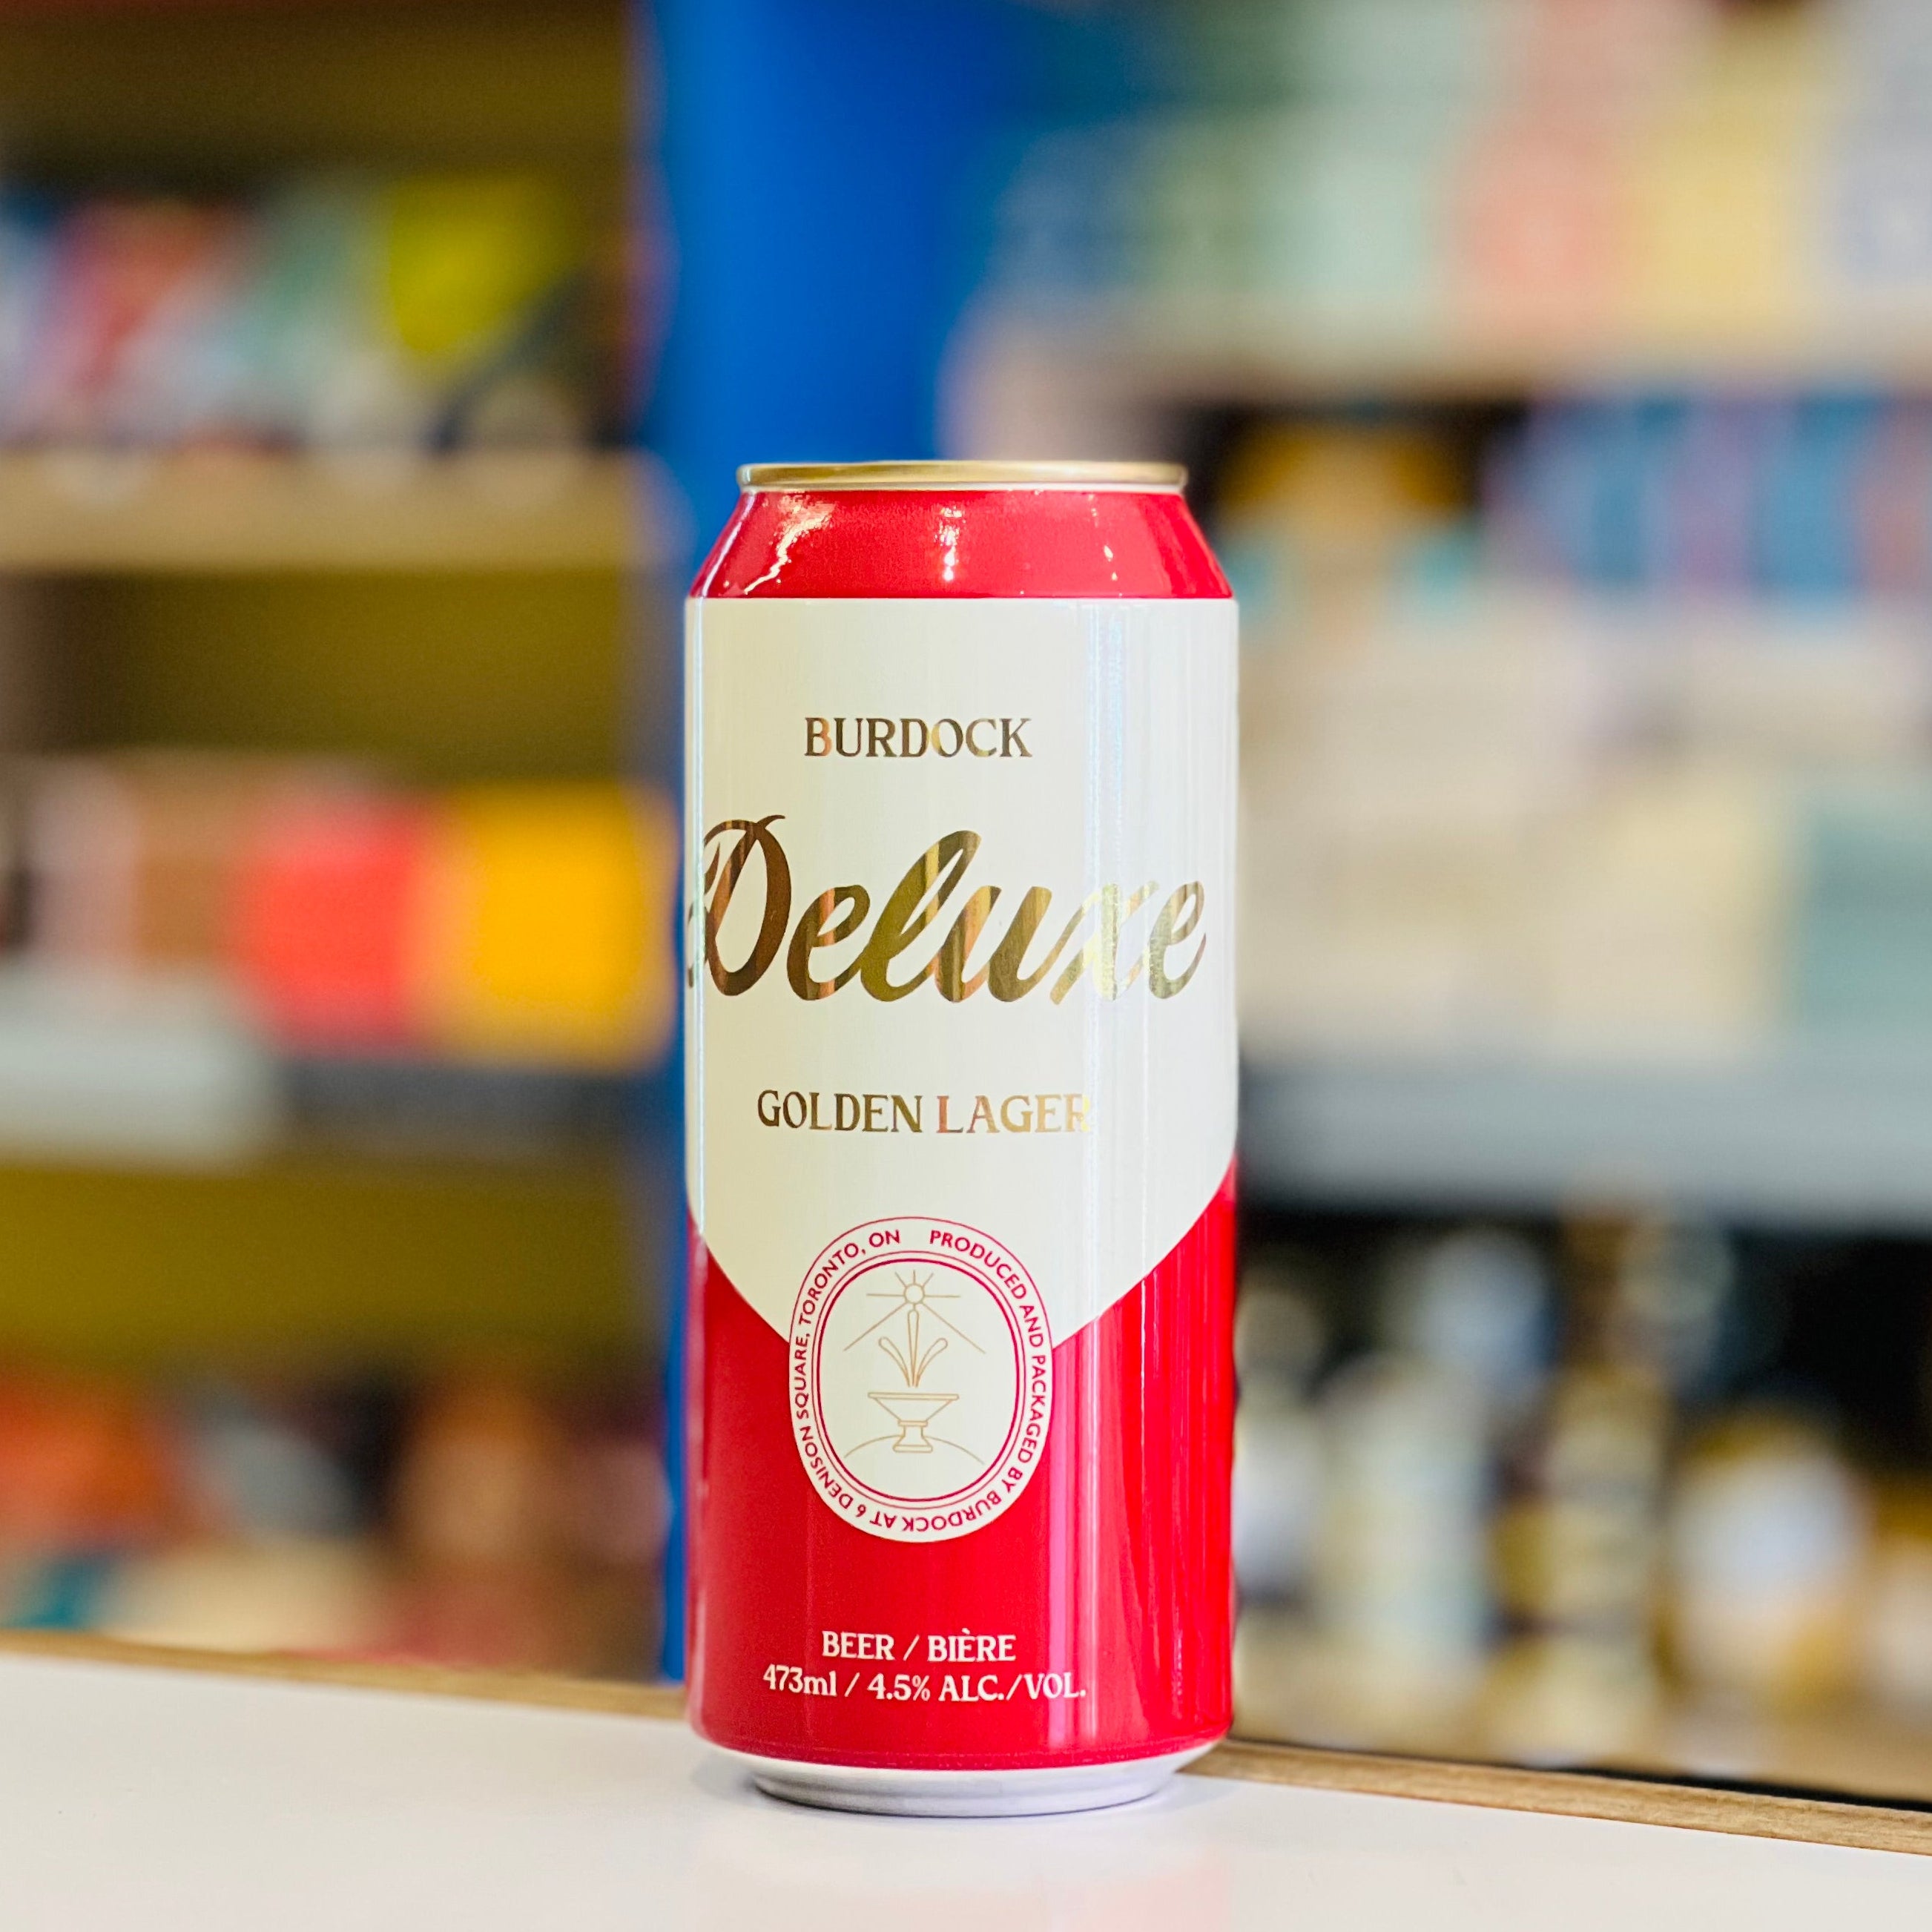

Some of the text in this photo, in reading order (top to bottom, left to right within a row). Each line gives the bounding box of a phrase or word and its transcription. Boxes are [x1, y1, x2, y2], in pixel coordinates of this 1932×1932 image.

[804, 716, 1032, 757] BURDOCK
[688, 814, 1206, 1005] Deluxe
[757, 1089, 1091, 1133] GOLDEN LAGER
[868, 1229, 901, 1249] ON
[799, 1242, 866, 1327] TORONTO,
[929, 1229, 1026, 1300] PRODUCED
[1019, 1304, 1044, 1348] AND
[1017, 1354, 1046, 1464] PACKAGED
[799, 1426, 854, 1510] DENISON
[1004, 1466, 1023, 1494] BY
[857, 1504, 866, 1519] 6
[869, 1510, 895, 1529] AT
[902, 1491, 1002, 1533] BURDOCK
[822, 1627, 1016, 1662] BEER / BIÈRE
[762, 1664, 837, 1697] 473ml
[844, 1672, 860, 1698] /
[866, 1672, 931, 1701] 4.5%
